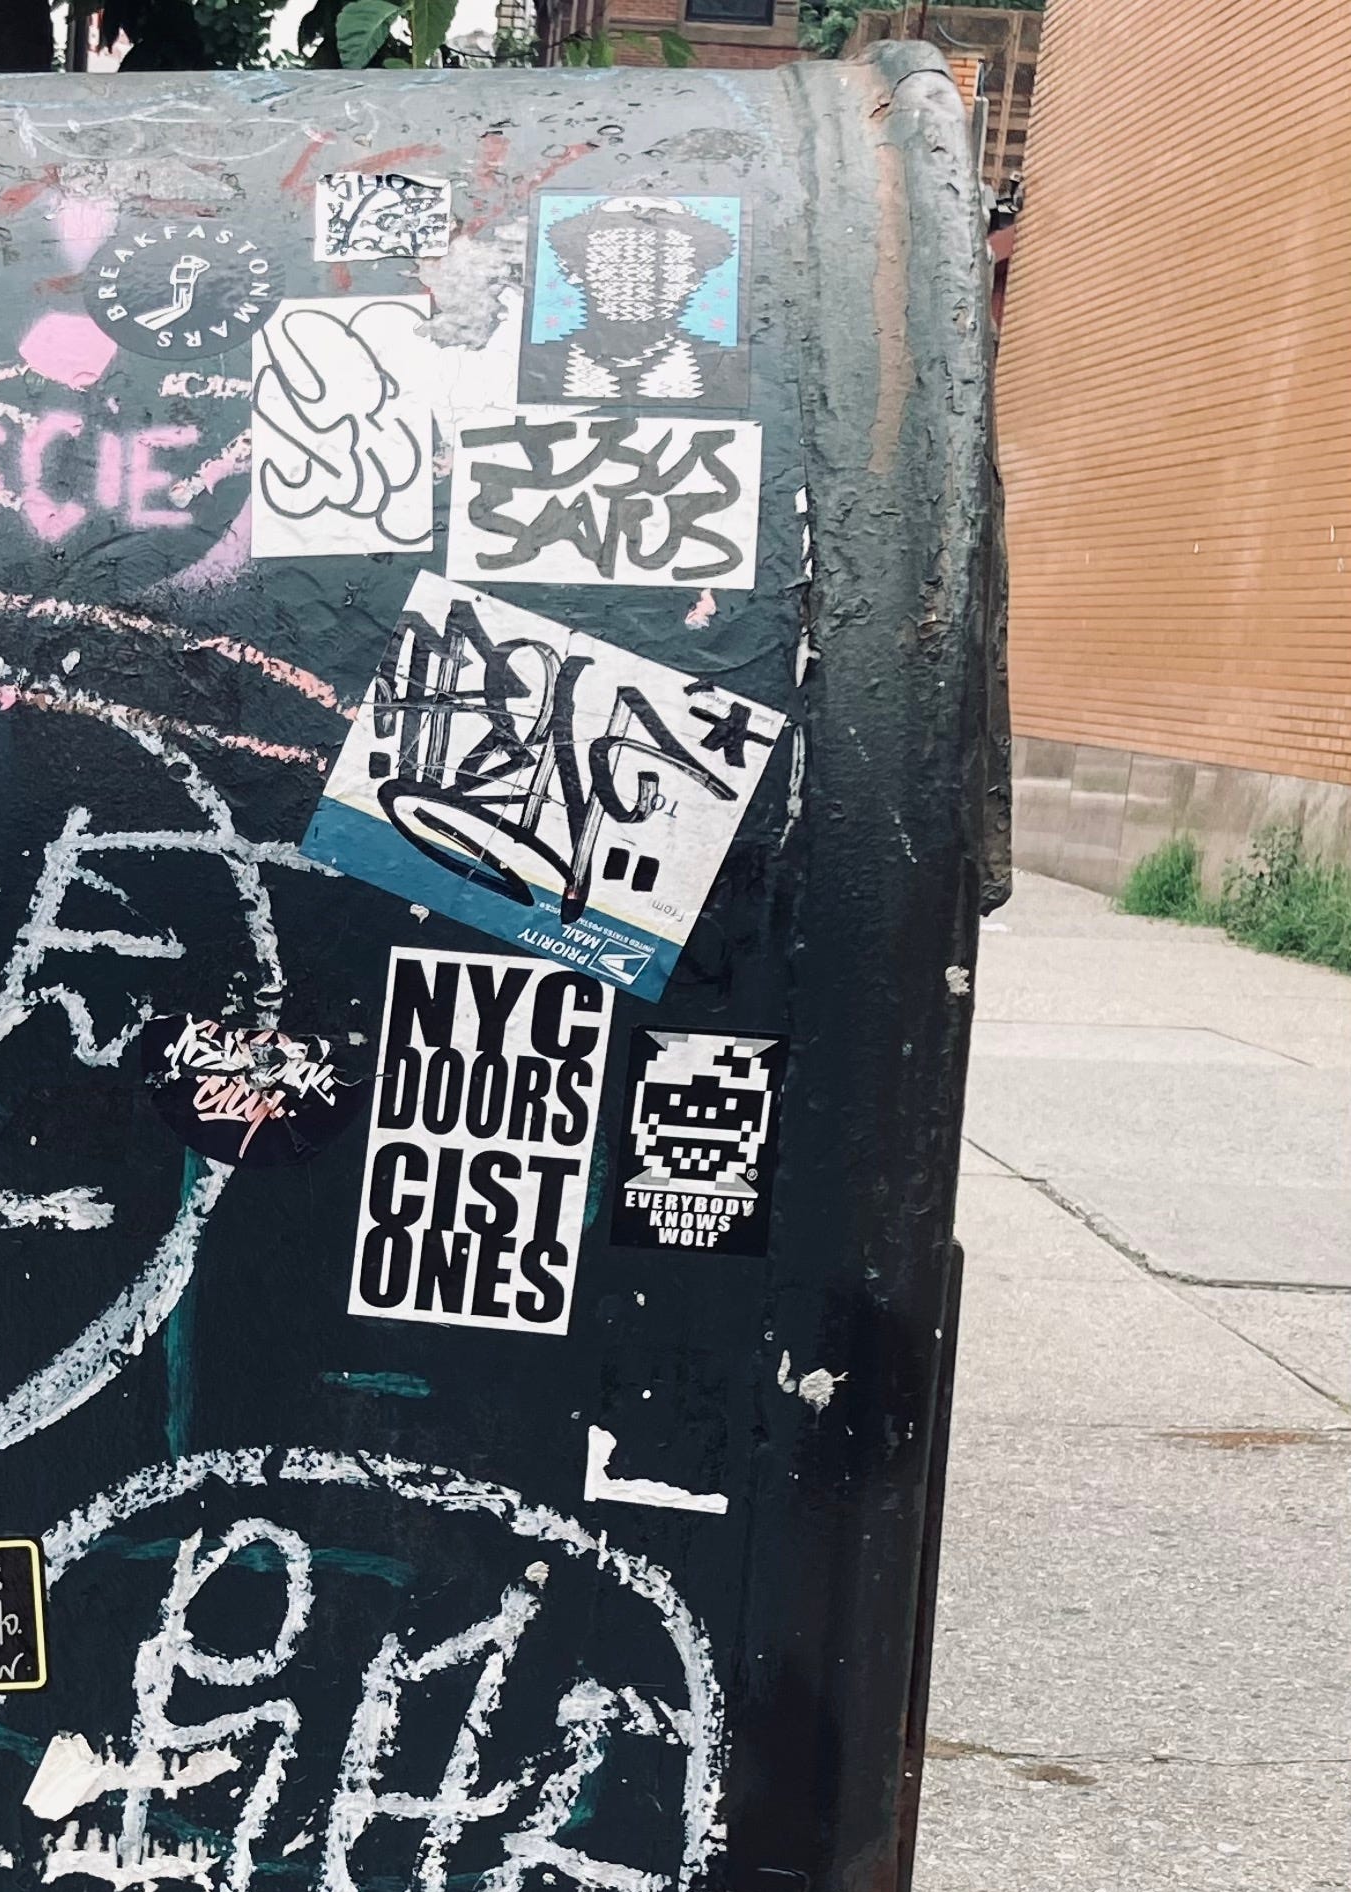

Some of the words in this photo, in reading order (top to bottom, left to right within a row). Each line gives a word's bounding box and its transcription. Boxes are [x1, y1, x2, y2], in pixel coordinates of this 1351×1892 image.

[98, 224, 258, 322] BREAKFAST
[248, 257, 271, 297] ON
[156, 301, 260, 348] MARS
[517, 928, 591, 967] PRIORITY
[561, 924, 601, 950] MAIL
[385, 957, 604, 1060] NYC
[377, 1045, 592, 1147] DOORS
[367, 1142, 583, 1243] CIST
[625, 1190, 755, 1217] EVERYBODY
[649, 1210, 732, 1232] KNOWS
[658, 1227, 719, 1248] WOLF
[359, 1223, 570, 1325] ONES
